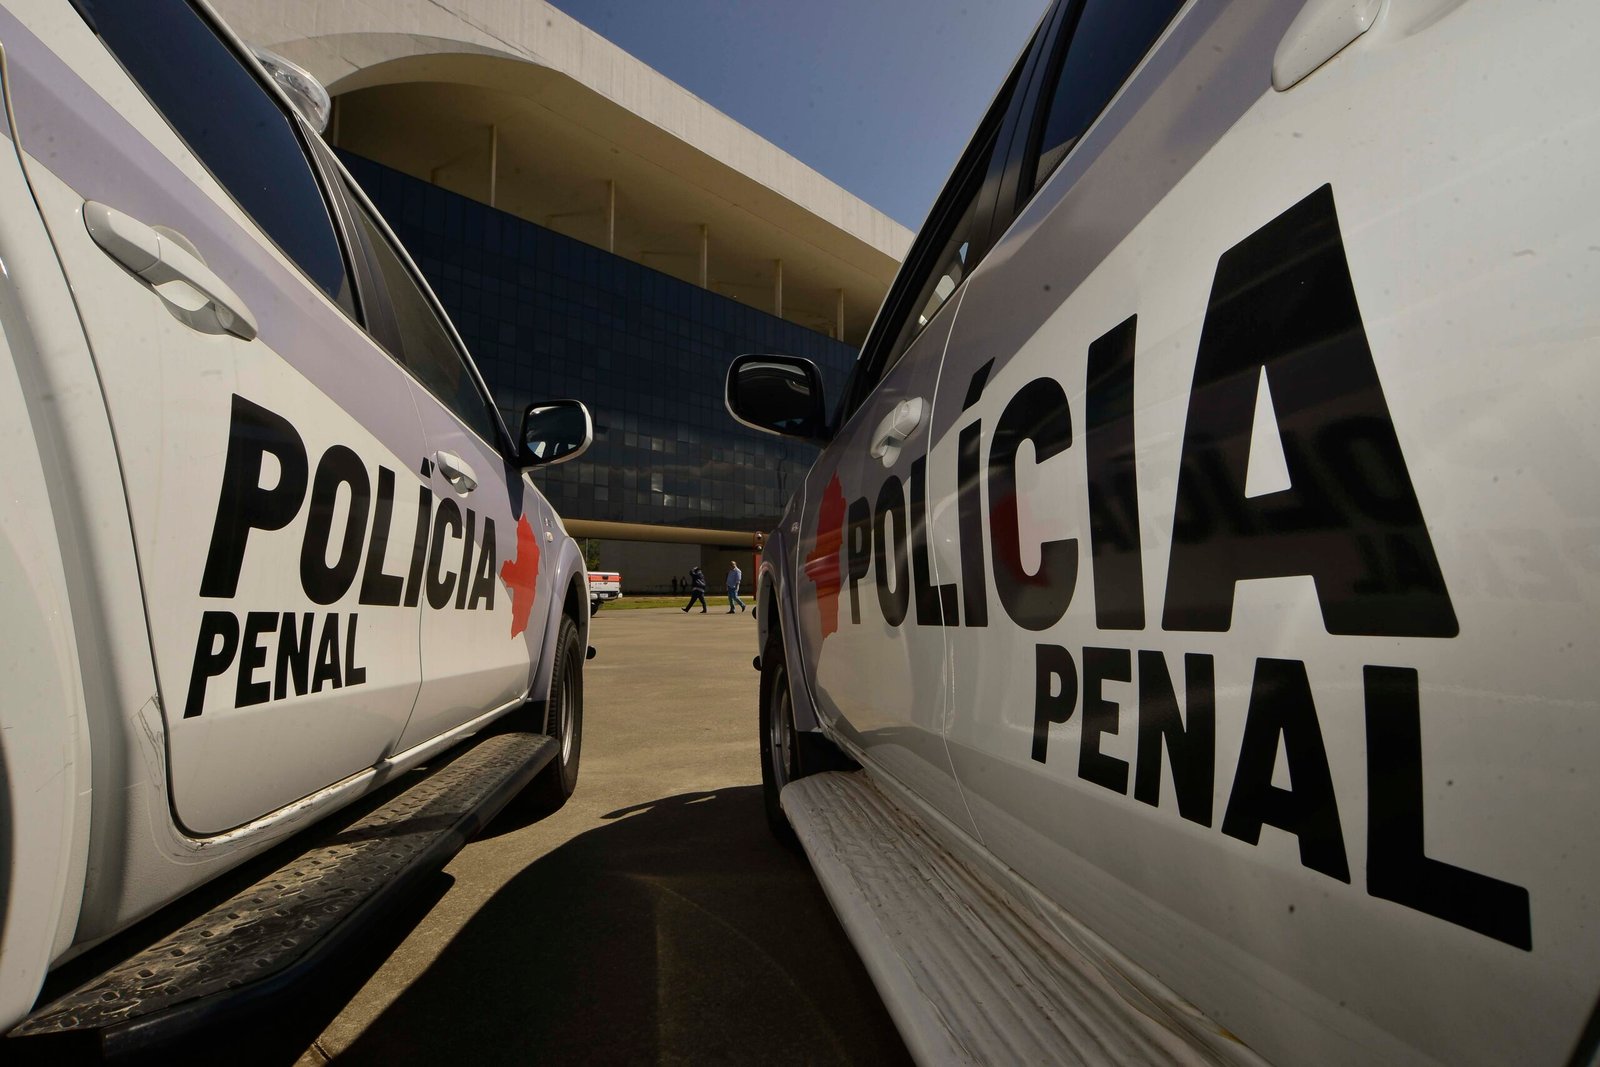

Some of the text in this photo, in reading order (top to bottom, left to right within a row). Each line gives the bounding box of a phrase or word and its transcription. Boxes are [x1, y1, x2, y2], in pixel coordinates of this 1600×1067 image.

[199, 393, 497, 610] POLÍCIA
[847, 182, 1460, 639] POLÍCIA
[183, 611, 366, 719] PENAL
[1031, 643, 1533, 951] PENAL
